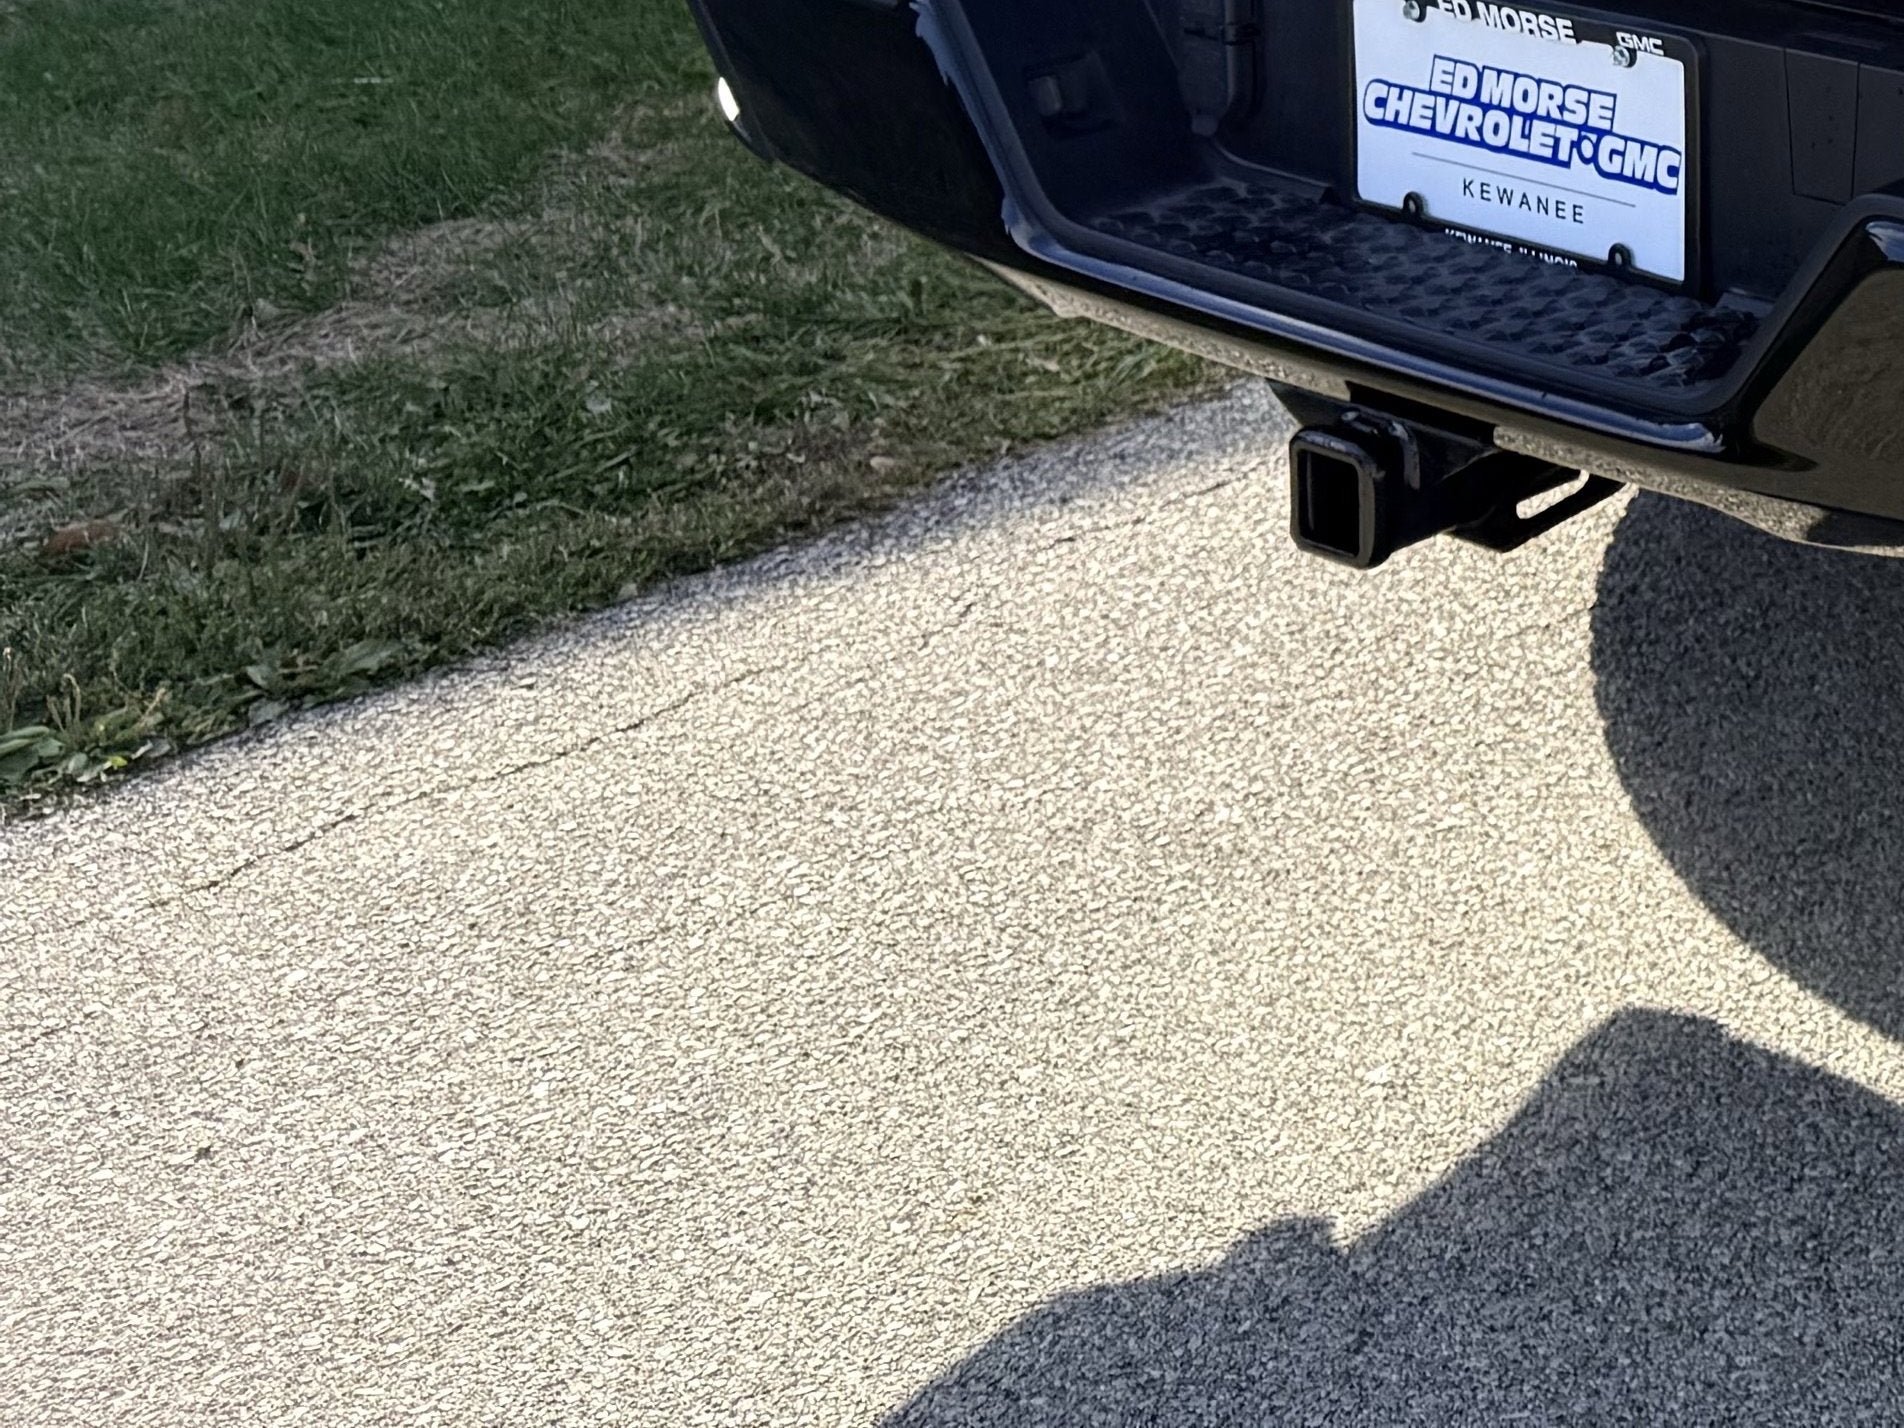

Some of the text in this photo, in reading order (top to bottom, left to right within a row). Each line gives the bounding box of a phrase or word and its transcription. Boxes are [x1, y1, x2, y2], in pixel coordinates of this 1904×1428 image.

[1476, 1, 1576, 43] MORSE
[1616, 31, 1665, 56] GMC
[1430, 55, 1617, 131] ED MORSE
[1463, 178, 1584, 225] KEWANEE
